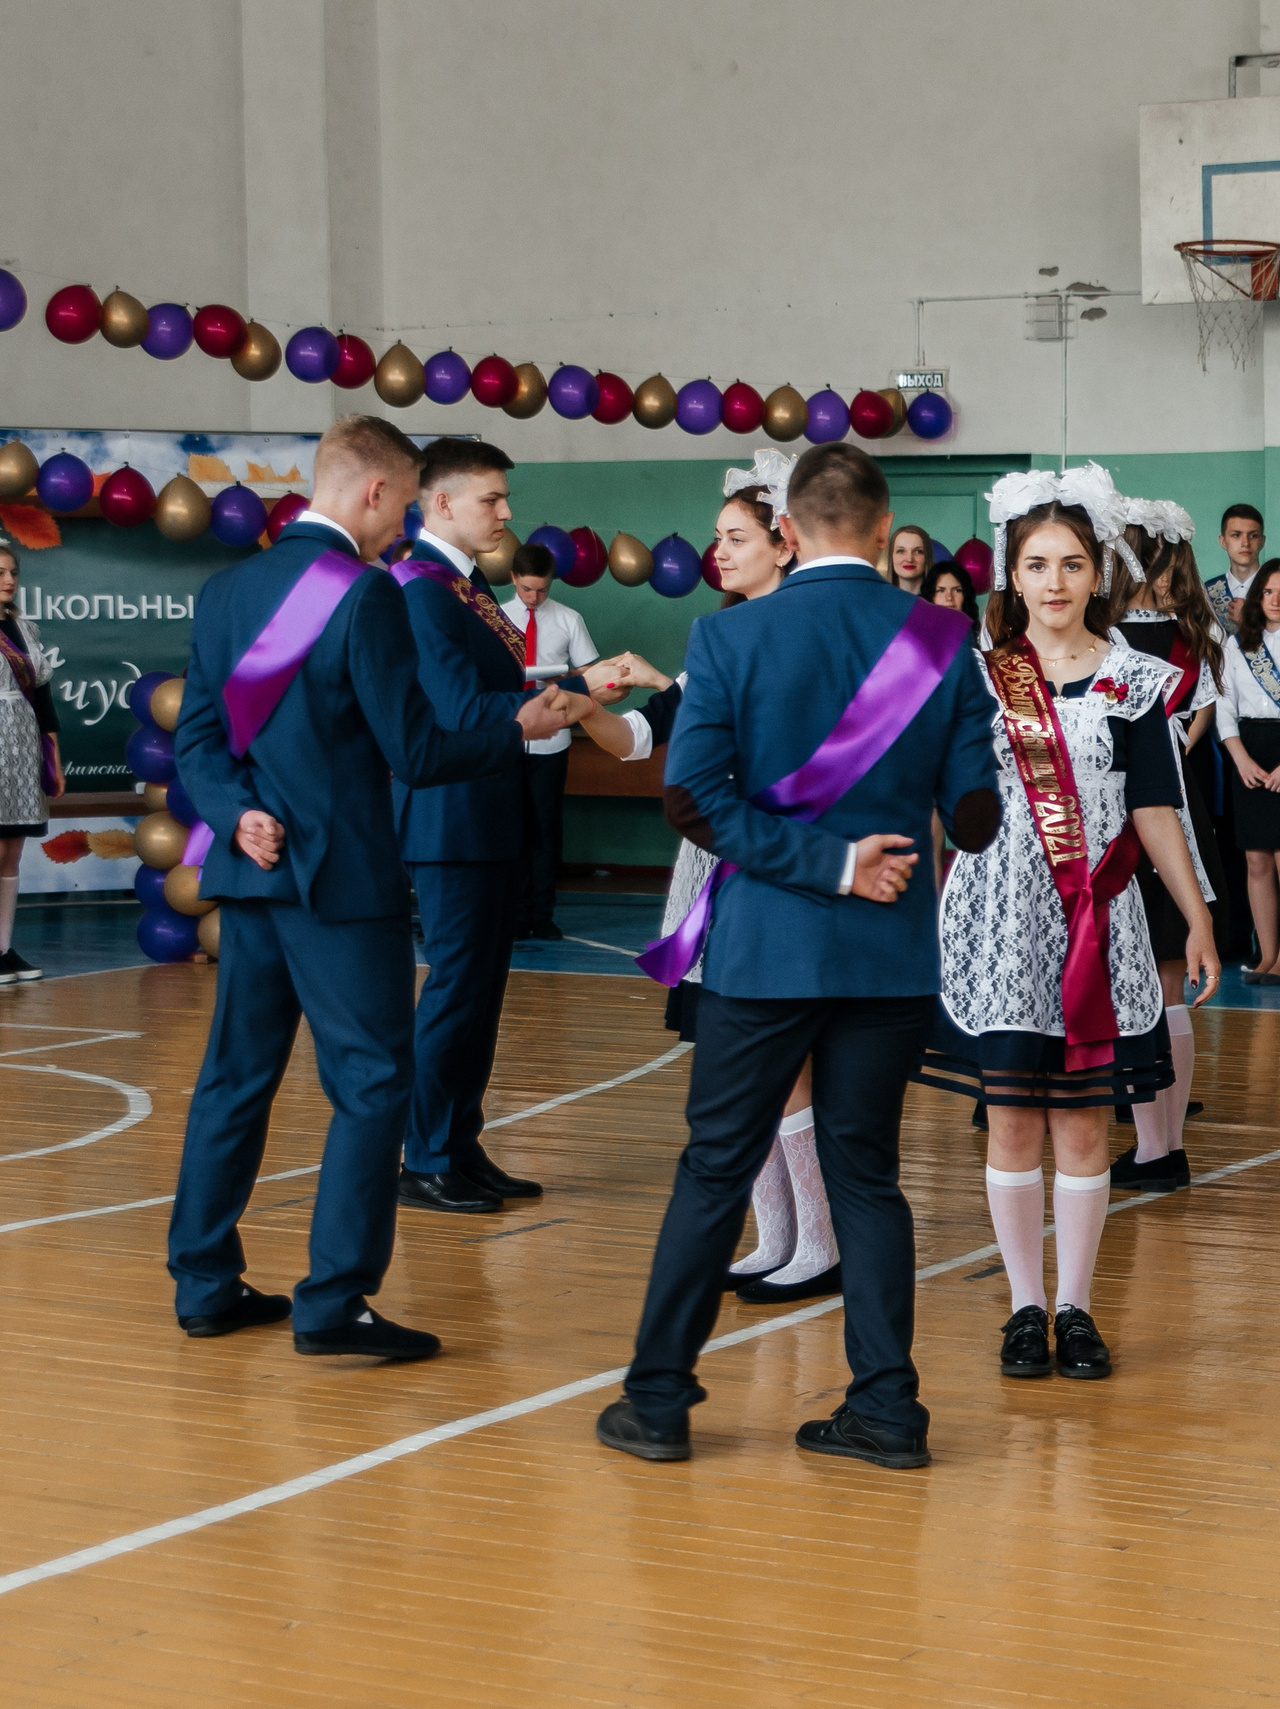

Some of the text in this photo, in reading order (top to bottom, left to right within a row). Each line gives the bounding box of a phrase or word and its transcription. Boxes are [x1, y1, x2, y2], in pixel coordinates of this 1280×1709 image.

[898, 374, 942, 388] ВЫХОД
[20, 586, 195, 620] Школьны
[60, 661, 142, 726] чуд
[999, 663, 1088, 867] Выпускница 2021
